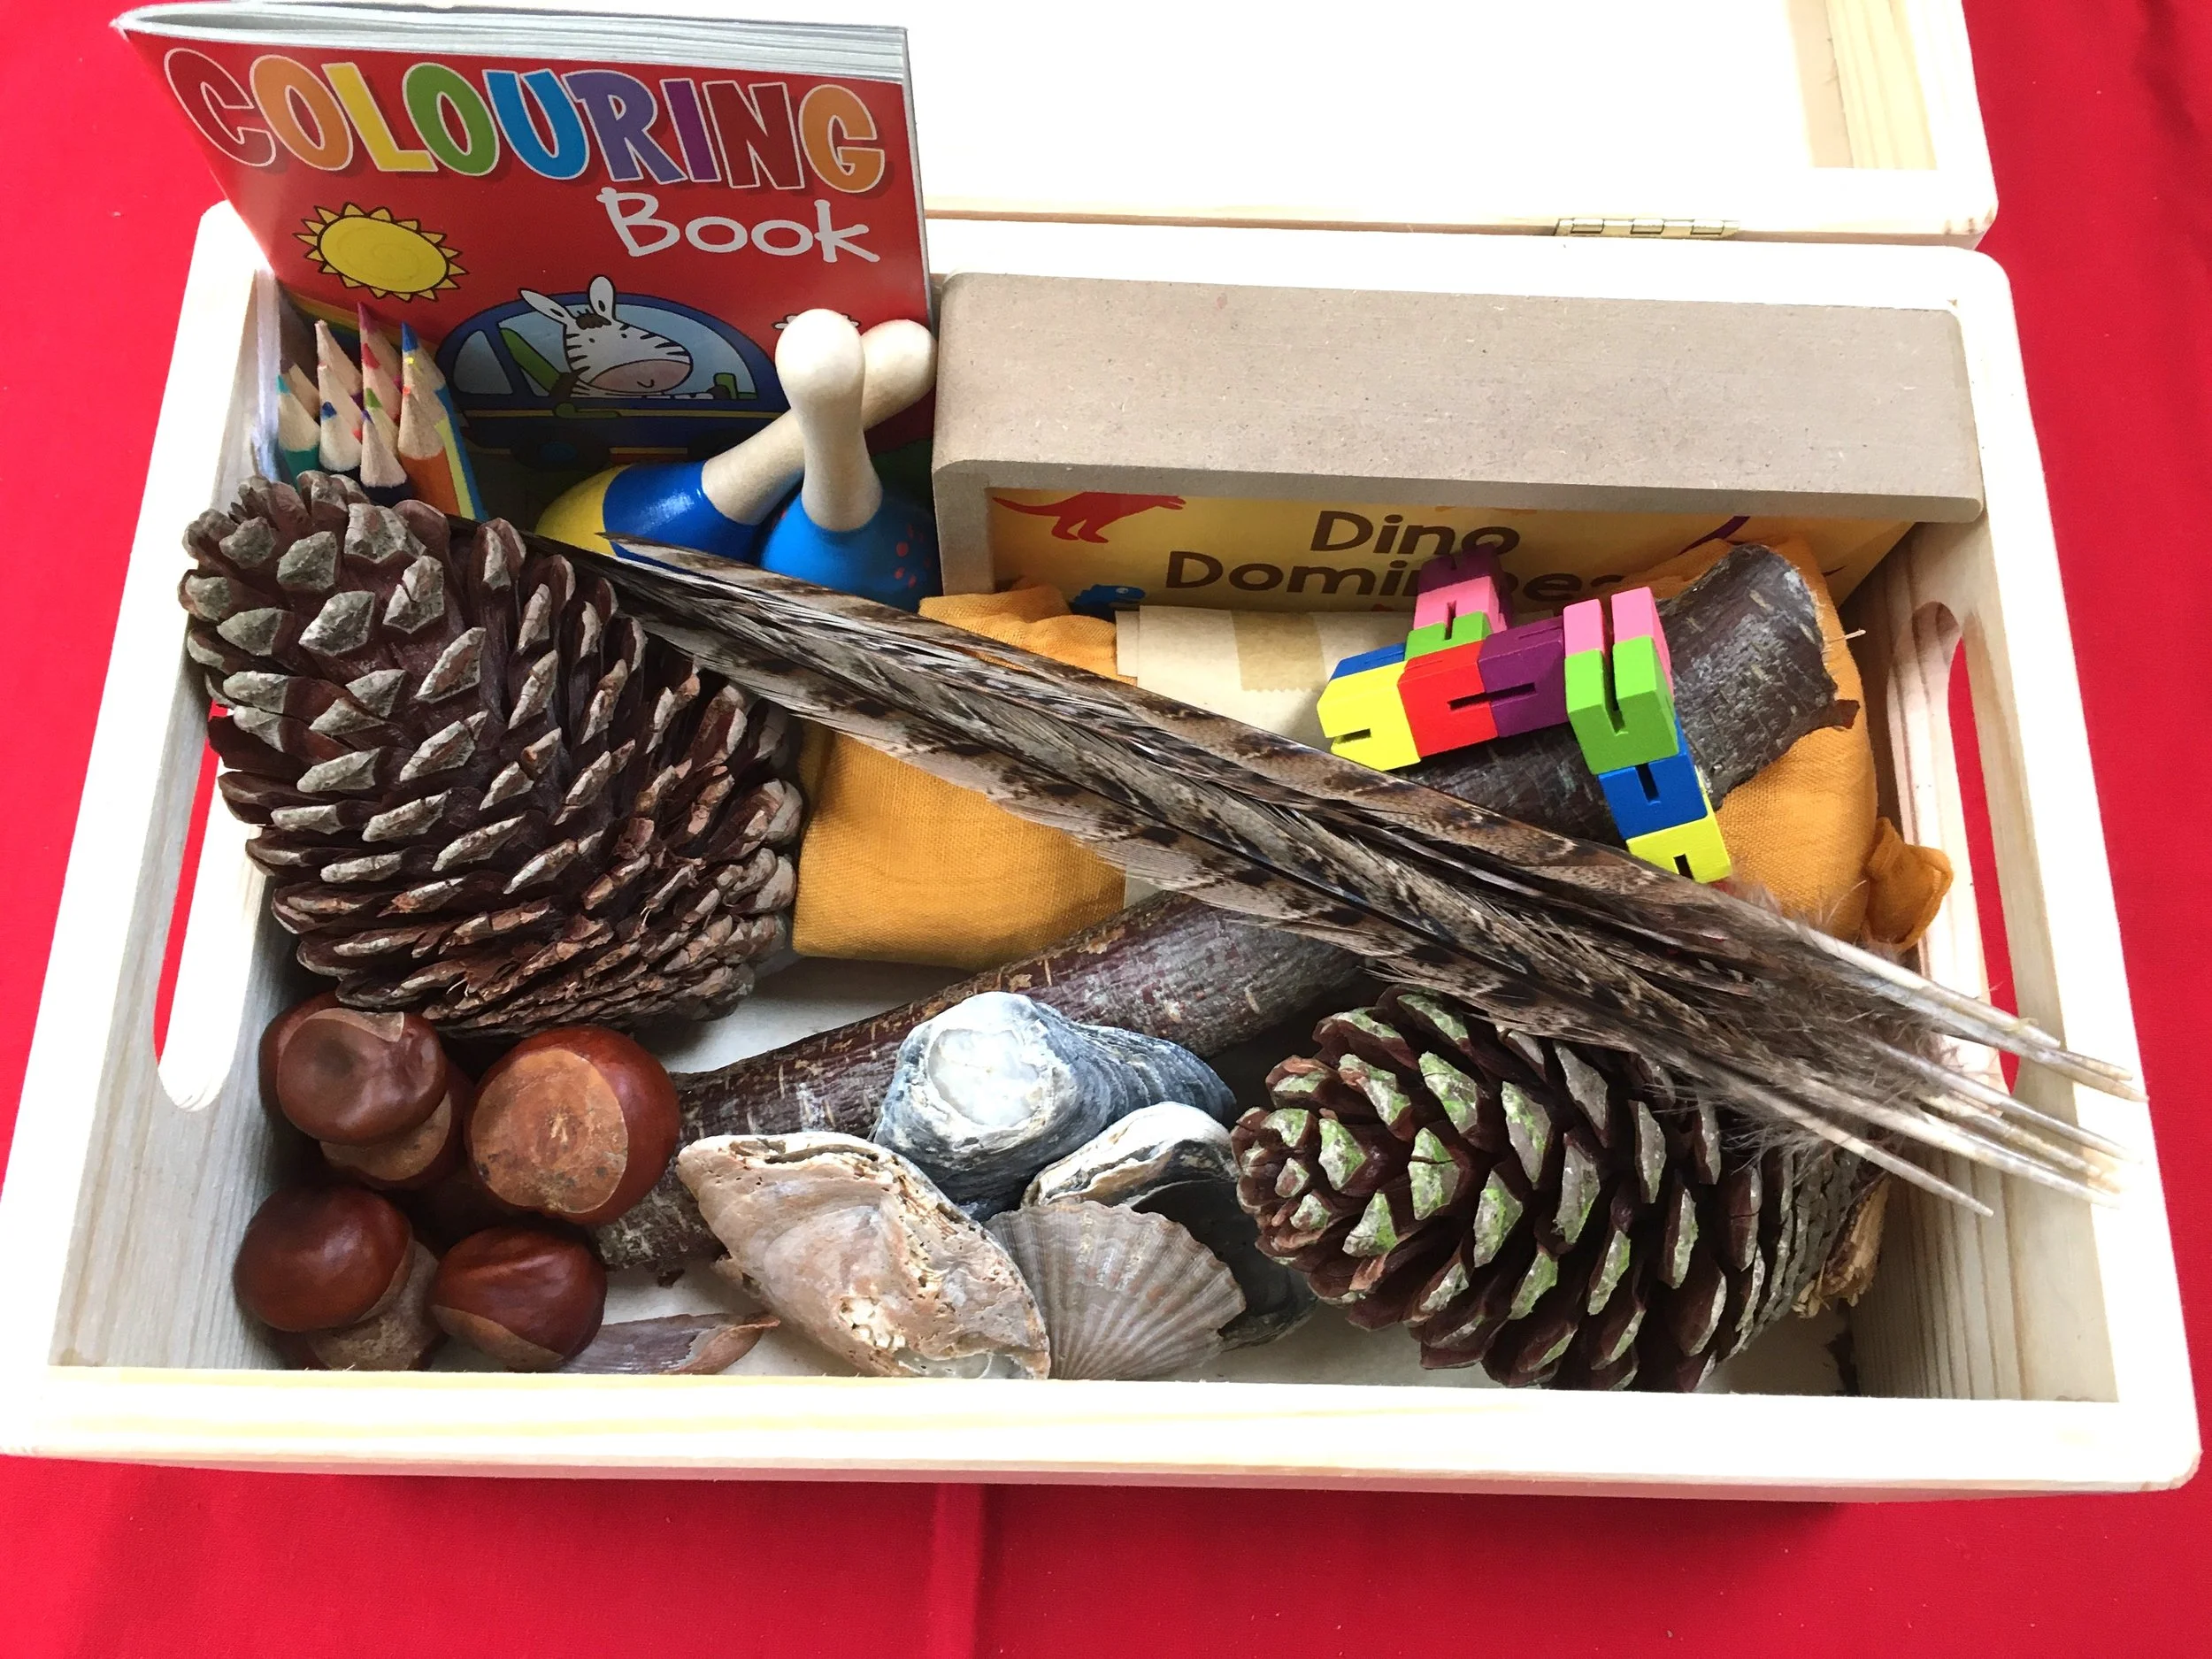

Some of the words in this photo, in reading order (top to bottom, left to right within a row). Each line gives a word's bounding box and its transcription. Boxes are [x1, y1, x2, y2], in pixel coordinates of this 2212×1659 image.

[163, 48, 887, 194] COLOURING
[596, 187, 880, 263] Book
[1310, 510, 1520, 557] Dino
[1165, 550, 1625, 602] Domie
